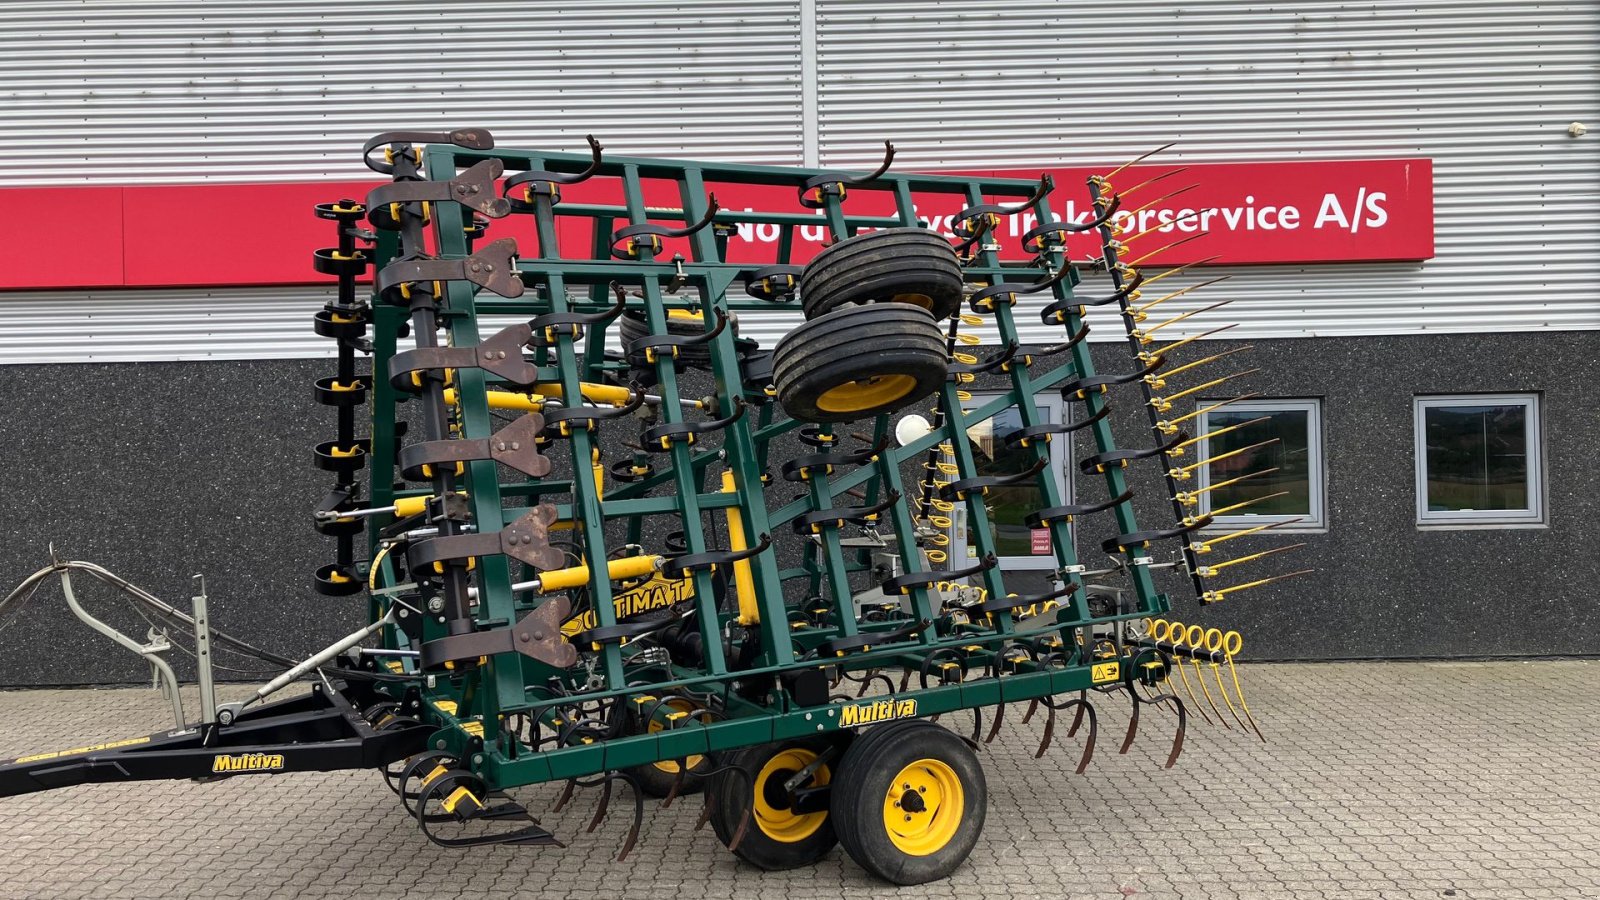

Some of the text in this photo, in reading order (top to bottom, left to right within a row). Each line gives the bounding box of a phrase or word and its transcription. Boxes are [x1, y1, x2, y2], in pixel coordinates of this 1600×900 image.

[1314, 187, 1388, 233] A/S
[839, 698, 917, 728] Multiva
[213, 753, 285, 772] Multiva
